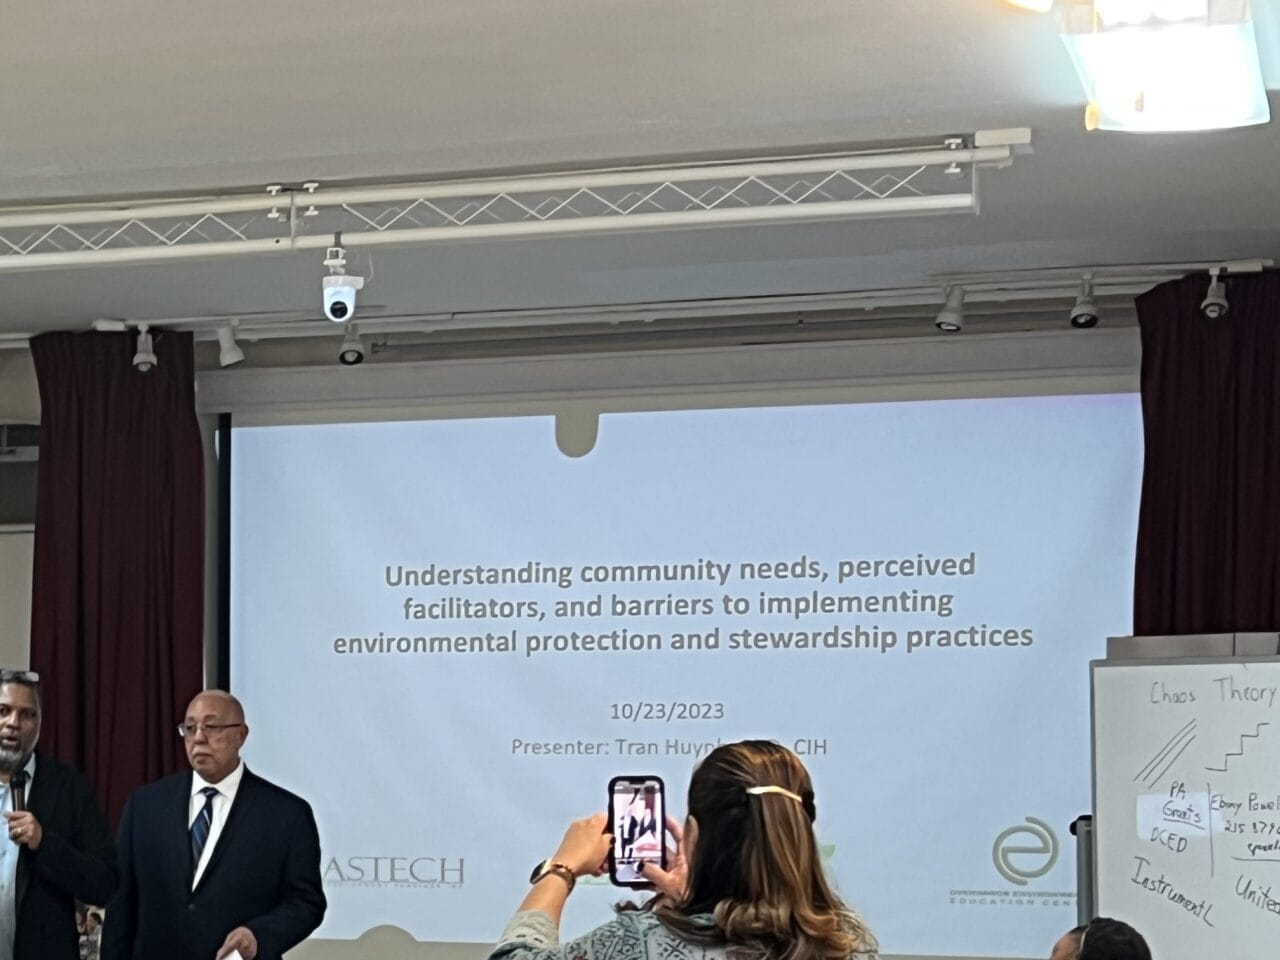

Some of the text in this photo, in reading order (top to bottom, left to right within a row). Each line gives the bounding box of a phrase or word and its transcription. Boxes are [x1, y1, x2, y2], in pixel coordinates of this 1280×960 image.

[385, 552, 976, 589] Understanding community needs, perceived
[403, 589, 954, 621] facilitators, and barriers to implementing
[333, 624, 1034, 657] environmental protection and stewardship practices
[1150, 676, 1277, 709] Chaos Theory
[610, 703, 725, 721] 10/23/2023
[512, 739, 609, 755] Presenter:
[614, 739, 658, 755] Tran
[794, 739, 827, 755] CIH
[323, 856, 464, 884] ASTECH
